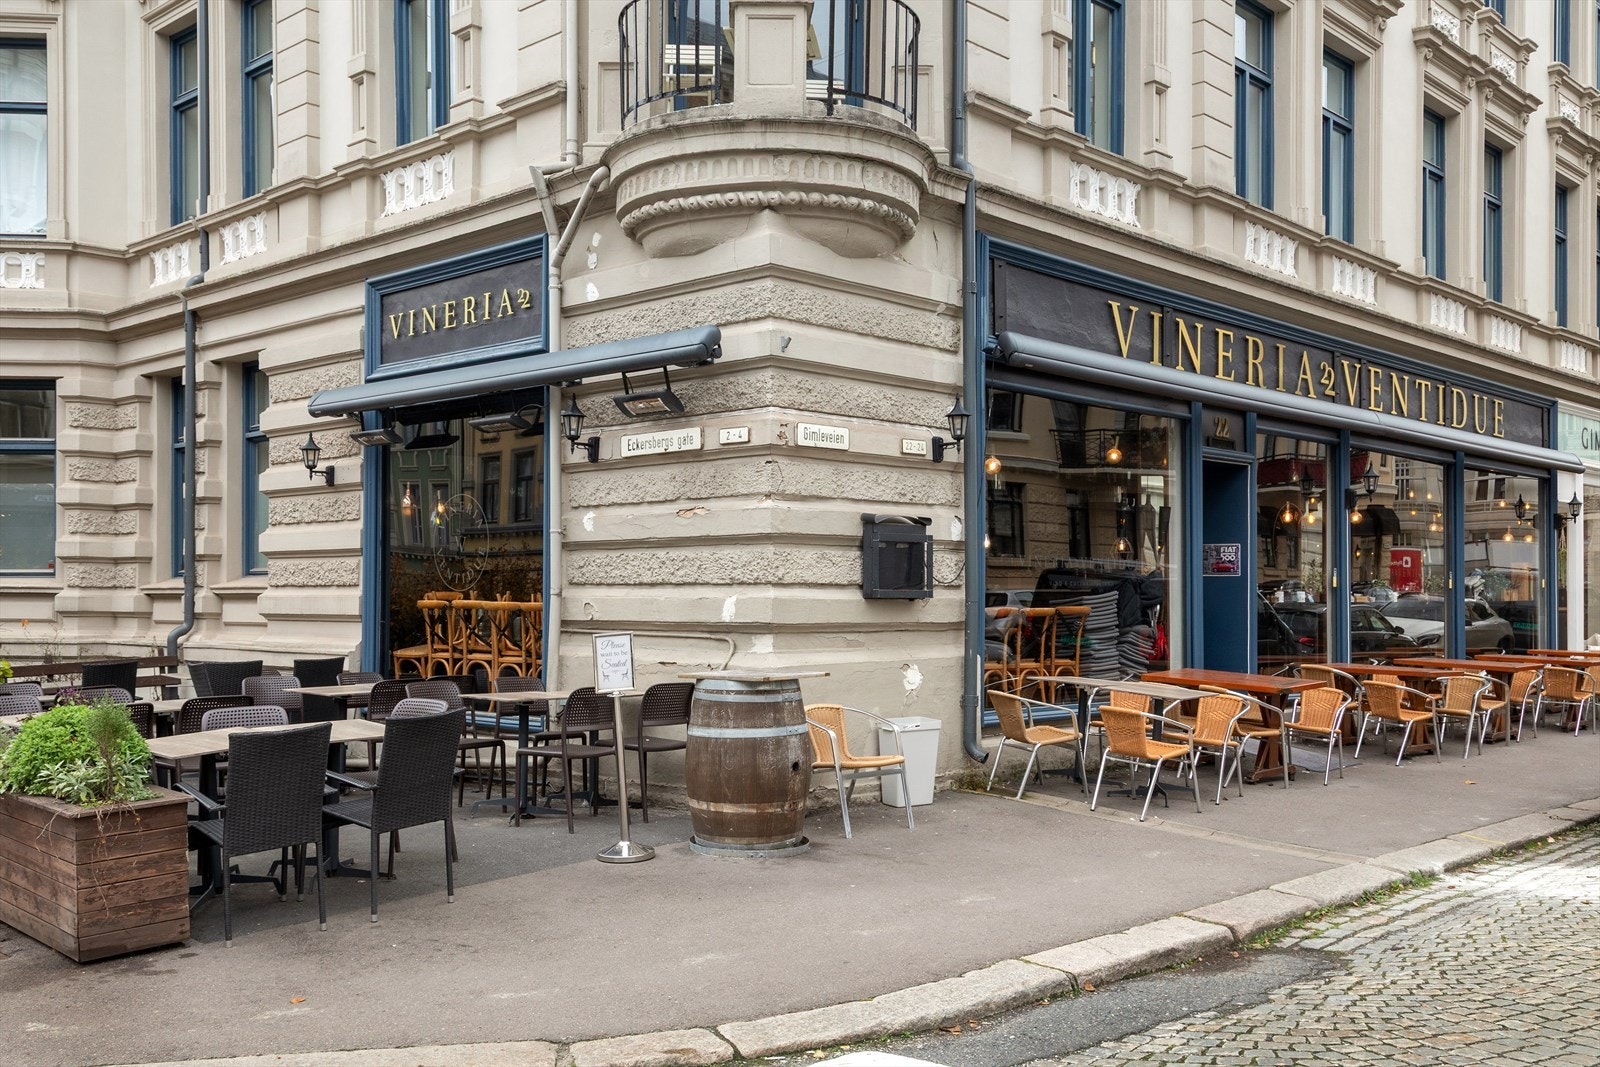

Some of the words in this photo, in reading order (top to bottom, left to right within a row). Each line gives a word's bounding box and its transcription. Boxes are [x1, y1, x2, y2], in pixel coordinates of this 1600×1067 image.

[389, 288, 514, 339] VINERIA
[1107, 300, 1317, 399] VINERIA
[1341, 359, 1505, 438] VENTIDUE
[1214, 415, 1230, 438] 22
[627, 436, 674, 452] Eckersbergs
[677, 434, 694, 449] gate
[803, 427, 845, 444] Gimleveien
[1220, 552, 1236, 561] 500
[600, 640, 625, 650] Please
[601, 659, 628, 669] Seated
